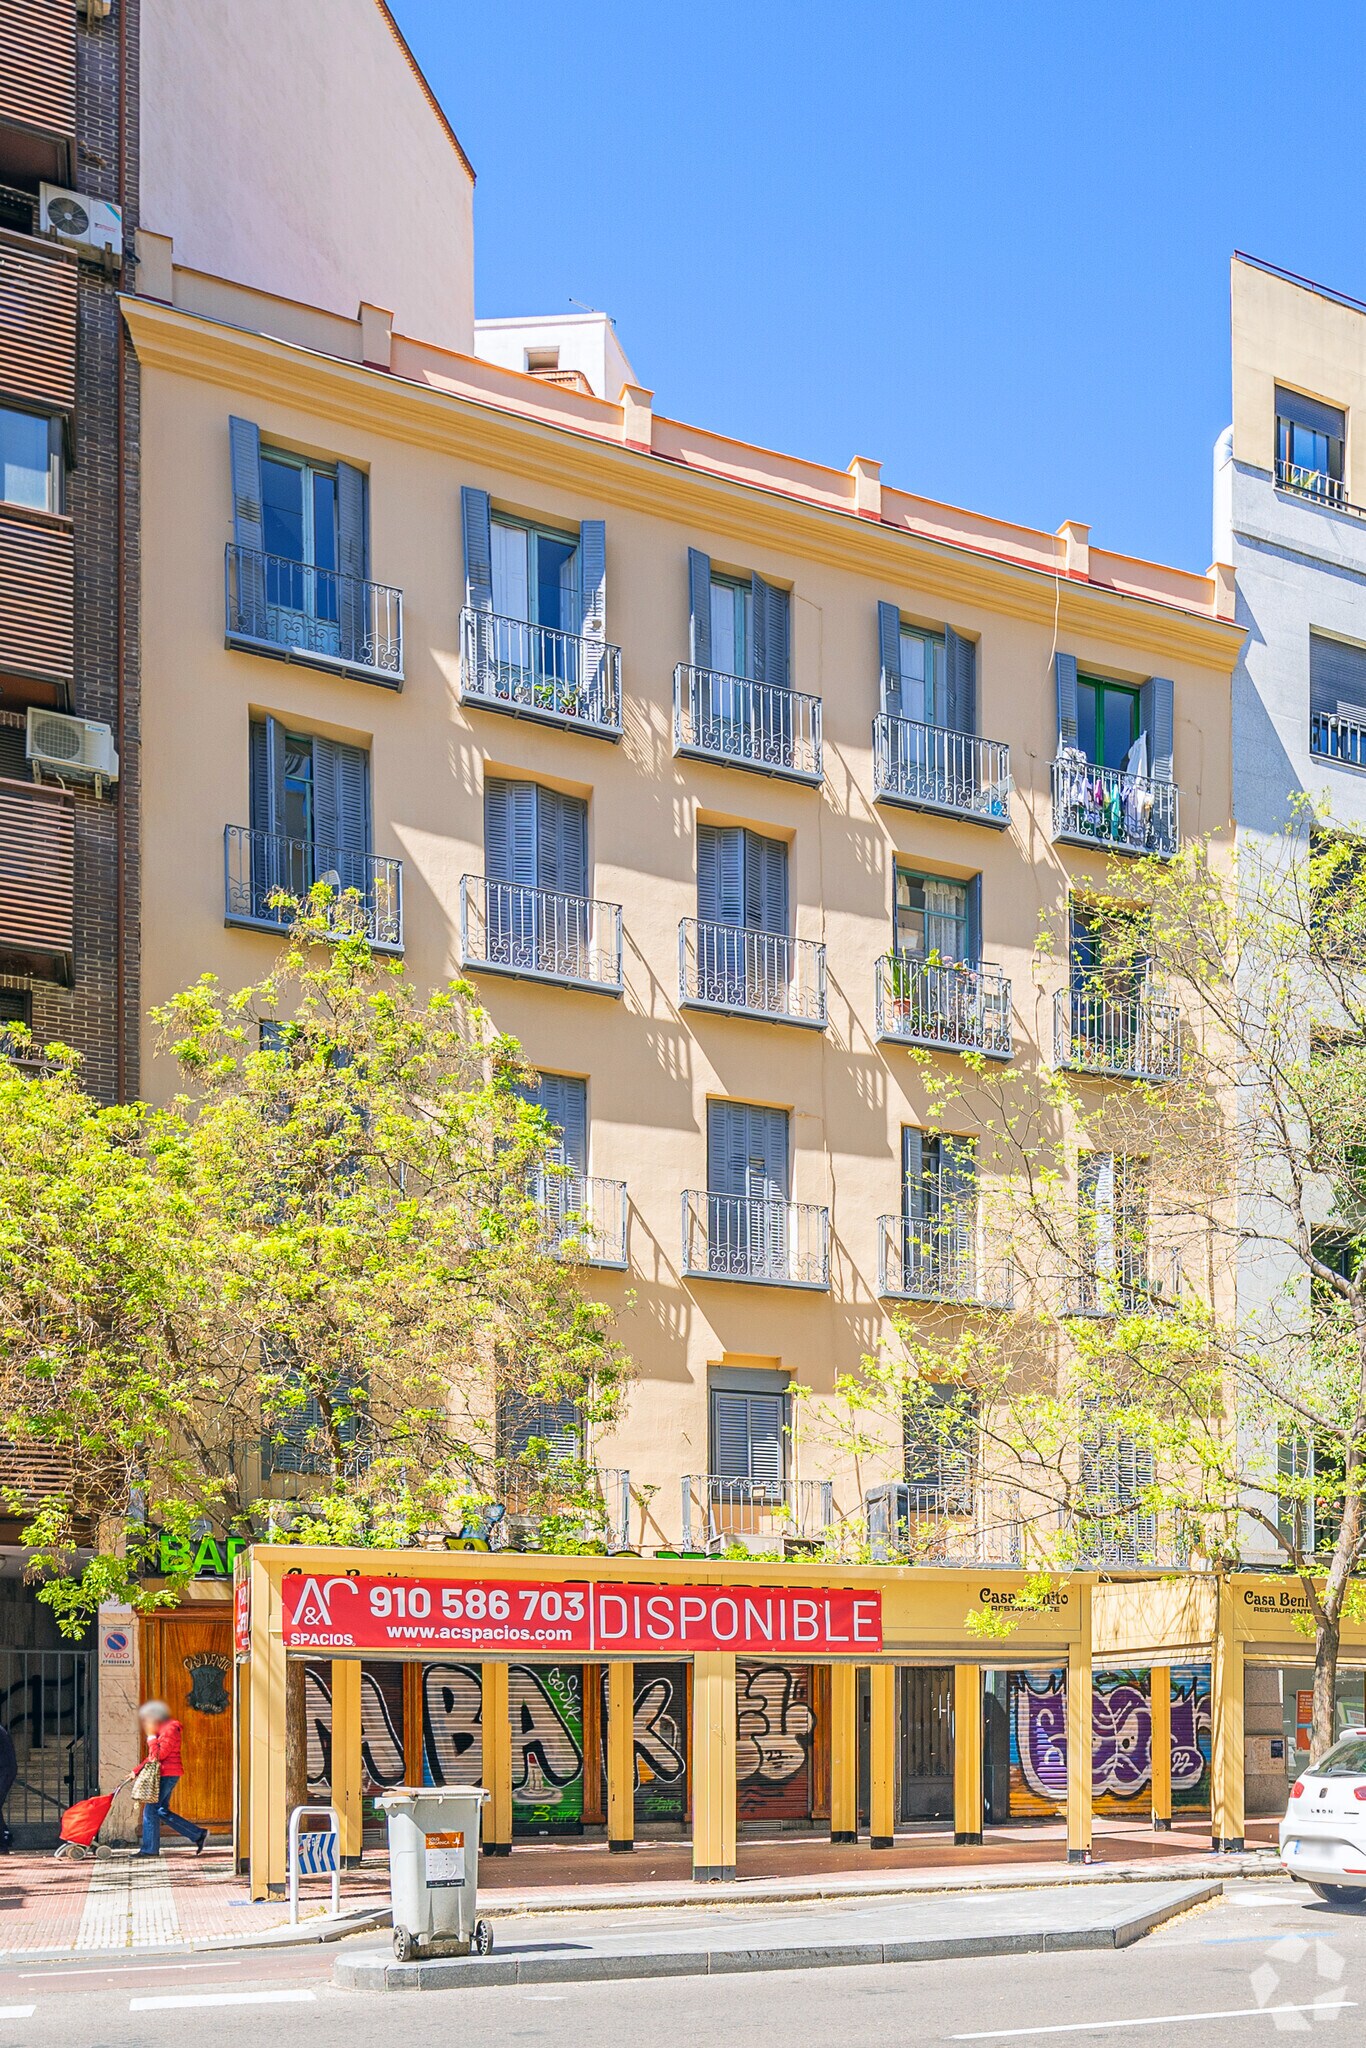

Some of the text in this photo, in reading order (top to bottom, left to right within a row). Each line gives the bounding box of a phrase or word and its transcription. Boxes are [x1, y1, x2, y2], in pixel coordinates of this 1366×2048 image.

[369, 1586, 585, 1622] 910 586 703
[979, 1587, 1069, 1605] Casa nito
[1243, 1590, 1309, 1607] Casa Beni
[599, 1595, 879, 1643] DISPONIBLE
[290, 1632, 353, 1646] SPACIOS
[386, 1624, 573, 1643] www.acspacios.com
